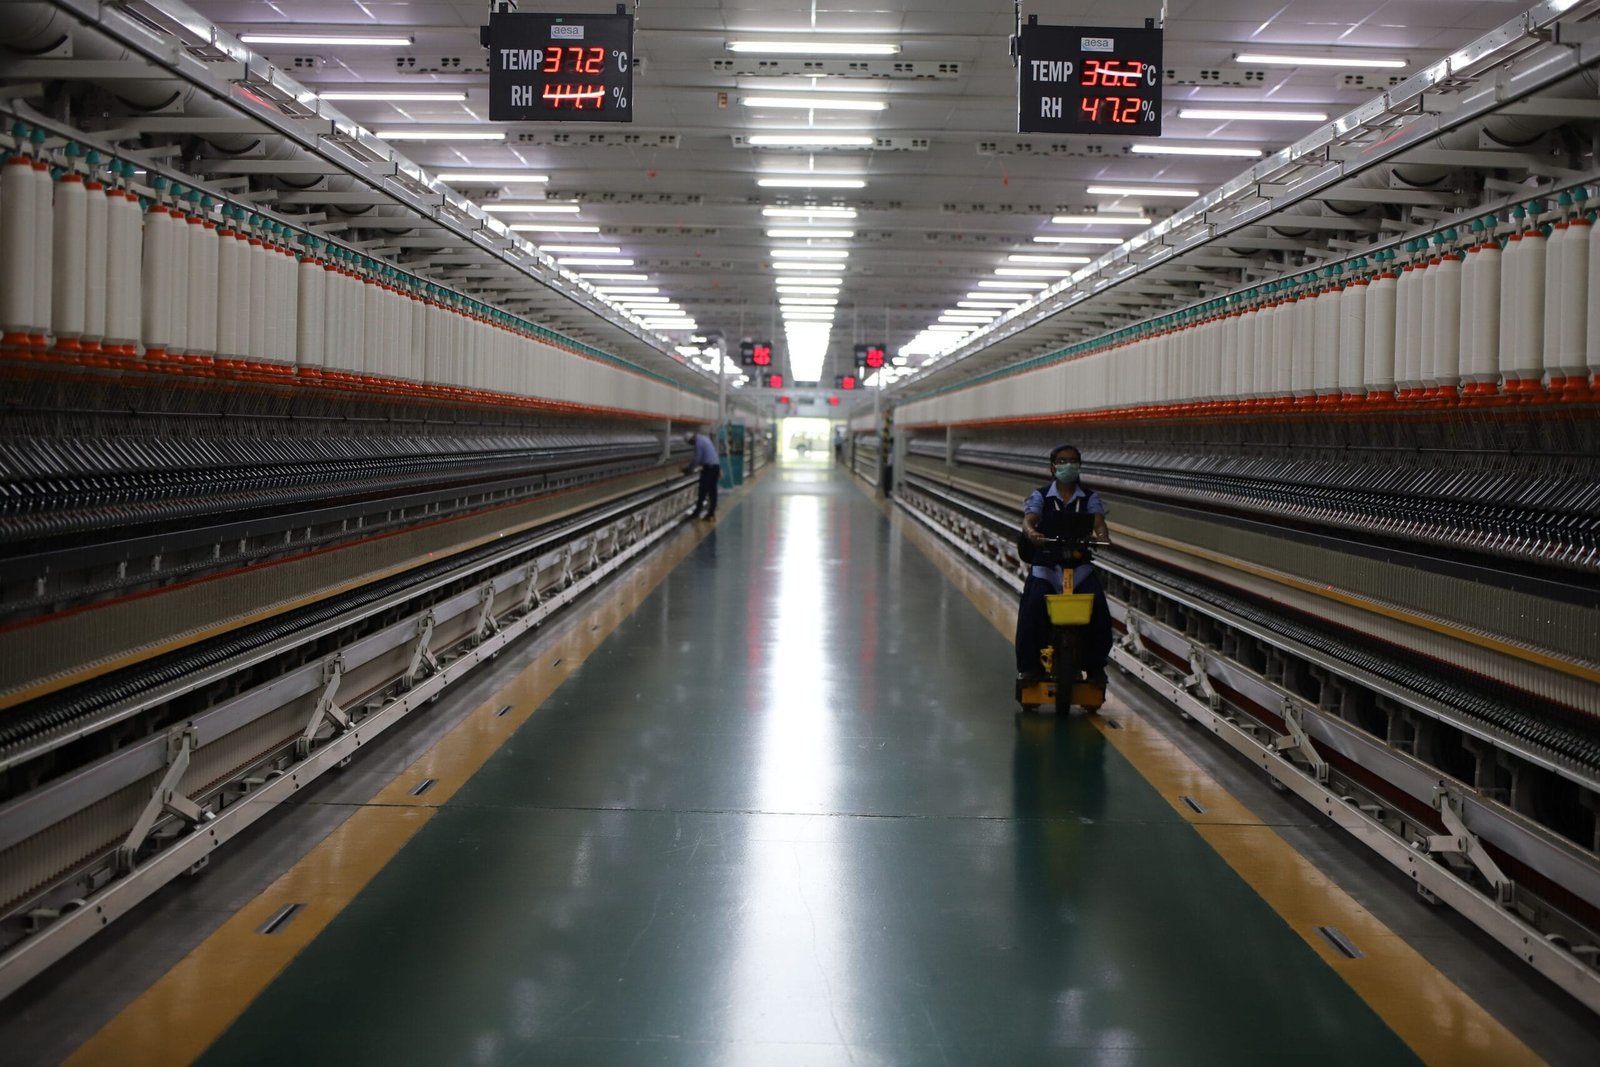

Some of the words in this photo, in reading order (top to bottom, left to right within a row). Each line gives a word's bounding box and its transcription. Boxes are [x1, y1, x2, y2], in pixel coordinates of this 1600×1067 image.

[501, 49, 543, 70] TEMP
[543, 47, 604, 73] 37.2
[1031, 60, 1073, 82] TEMP
[1082, 60, 1142, 86] 36.2
[511, 86, 532, 106] RH
[613, 87, 626, 108] %
[1041, 97, 1062, 118] RH
[1082, 98, 1141, 123] 47.2
[1142, 100, 1156, 122] %
